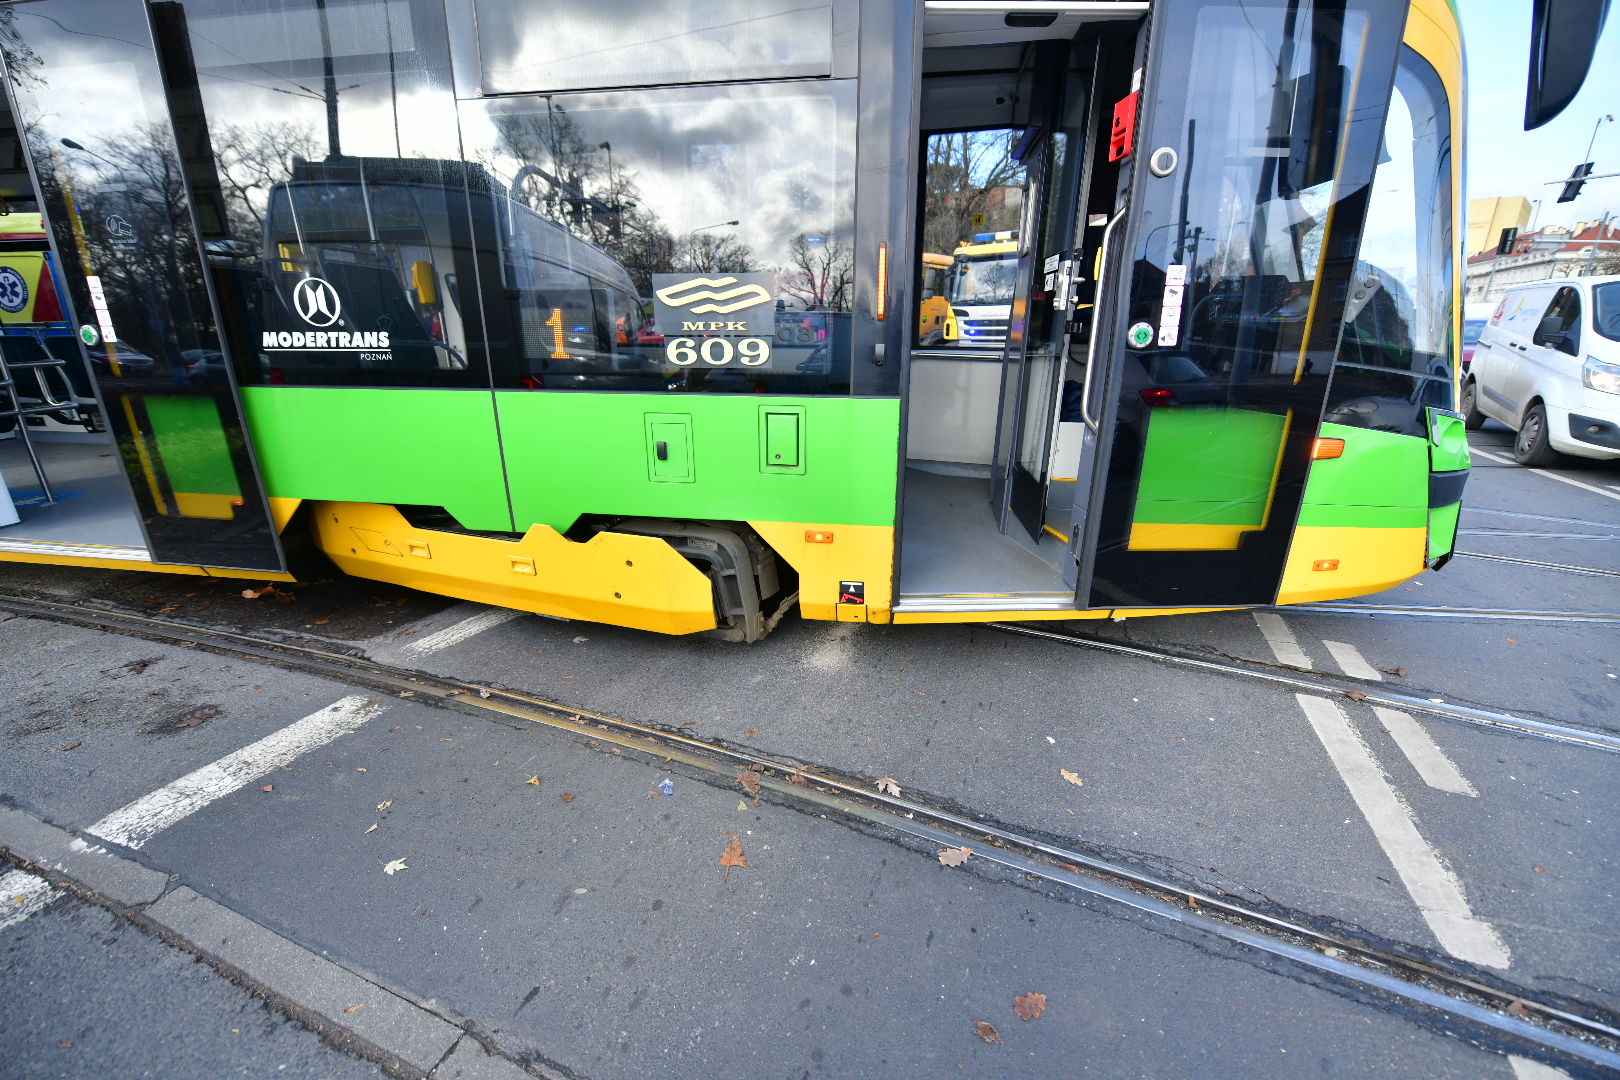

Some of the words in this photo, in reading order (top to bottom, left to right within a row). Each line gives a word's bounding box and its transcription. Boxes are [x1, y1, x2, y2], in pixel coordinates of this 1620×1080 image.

[545, 308, 570, 359] 1
[681, 321, 748, 331] MPK
[262, 331, 390, 347] MODERTRANS
[360, 352, 393, 361] POZNAŃ
[666, 337, 770, 366] 609
